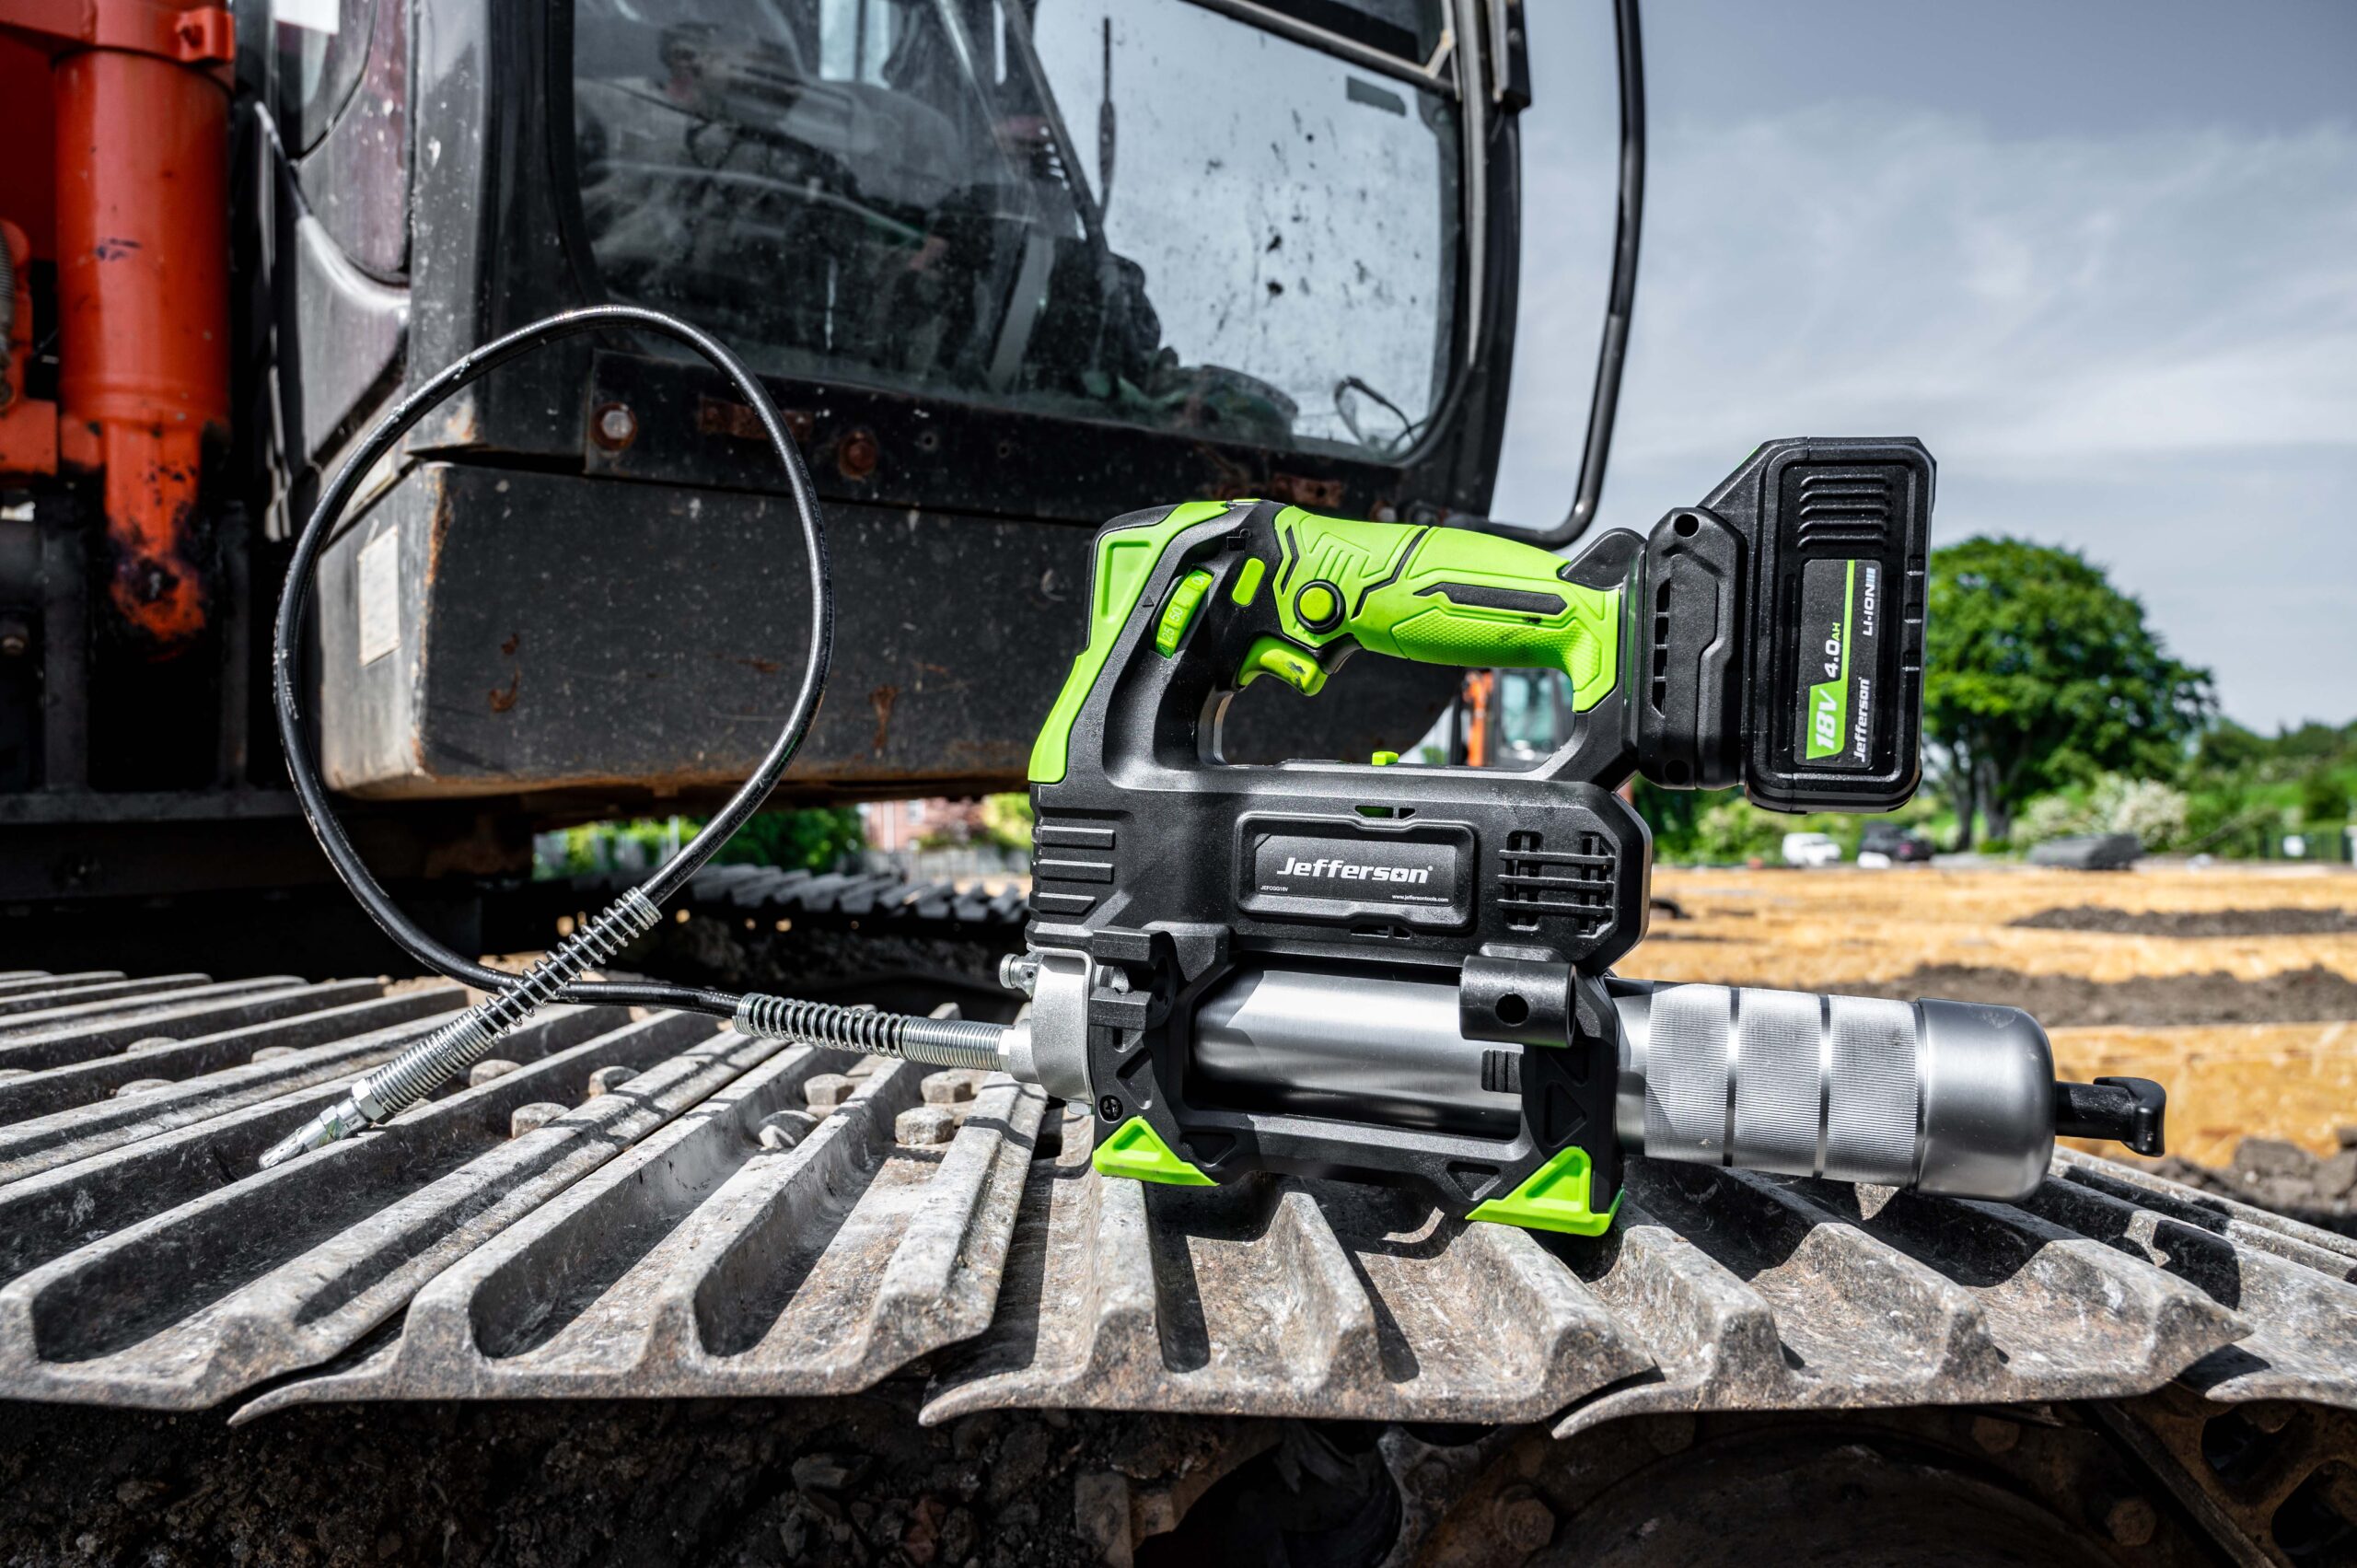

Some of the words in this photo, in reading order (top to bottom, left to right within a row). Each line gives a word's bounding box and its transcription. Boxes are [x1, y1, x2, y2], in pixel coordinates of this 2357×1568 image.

[1169, 607, 1183, 622] 50
[1162, 626, 1175, 643] 25
[1853, 679, 1870, 762] Jefferson
[1863, 584, 1875, 636] LI-ION
[1816, 689, 1837, 749] 18V
[1277, 857, 1428, 883] Jefferson
